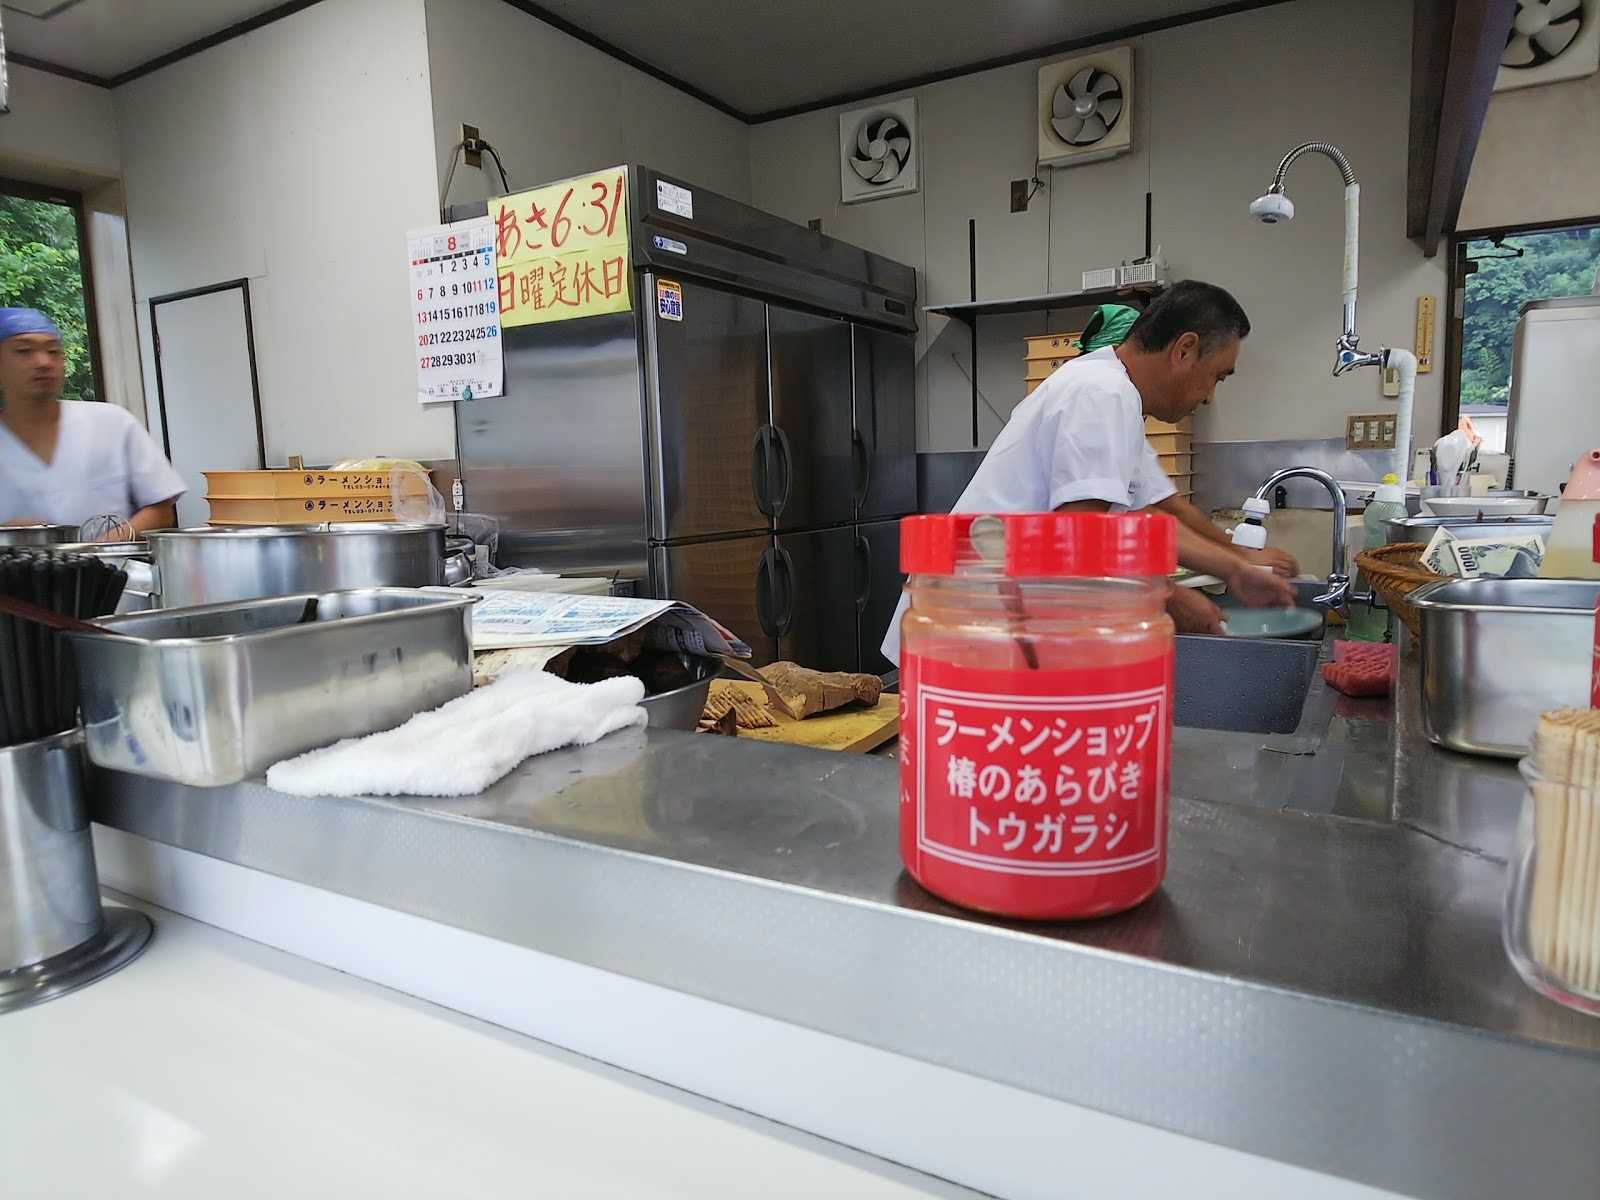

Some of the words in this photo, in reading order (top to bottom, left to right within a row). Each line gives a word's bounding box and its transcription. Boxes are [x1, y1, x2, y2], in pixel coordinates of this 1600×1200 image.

[447, 236, 457, 251] 8
[440, 262, 444, 274] 1
[451, 260, 457, 272] 2
[462, 258, 468, 270] 3
[473, 255, 478, 268] 4
[484, 254, 490, 266] 5
[417, 289, 423, 300] 6
[429, 287, 434, 299] 7
[440, 285, 446, 297] 8
[452, 283, 458, 295] 9
[462, 281, 472, 294] 10
[472, 279, 482, 292] 11
[485, 278, 494, 290] 12
[498, 256, 623, 313] 日曜定休日
[418, 311, 427, 324] 13
[428, 310, 438, 322] 14
[440, 308, 450, 320] 15
[452, 307, 463, 319] 16
[464, 305, 474, 318] 17
[475, 303, 484, 316] 18
[486, 301, 496, 313] 19
[418, 334, 429, 346] 20
[429, 333, 438, 345] 21
[440, 331, 452, 343] 22
[452, 330, 464, 342] 23
[465, 329, 475, 341] 24
[476, 327, 486, 339] 25
[486, 325, 497, 337] 26
[420, 357, 430, 369] 27
[431, 356, 441, 367] 28
[441, 354, 453, 366] 29
[454, 353, 466, 365] 30
[466, 352, 476, 364] 31
[1458, 546, 1477, 572] 1000
[934, 705, 1157, 757] ラーメンショップ
[947, 755, 1142, 806] 椿のあらびき
[968, 806, 1129, 854] トウガラシ
